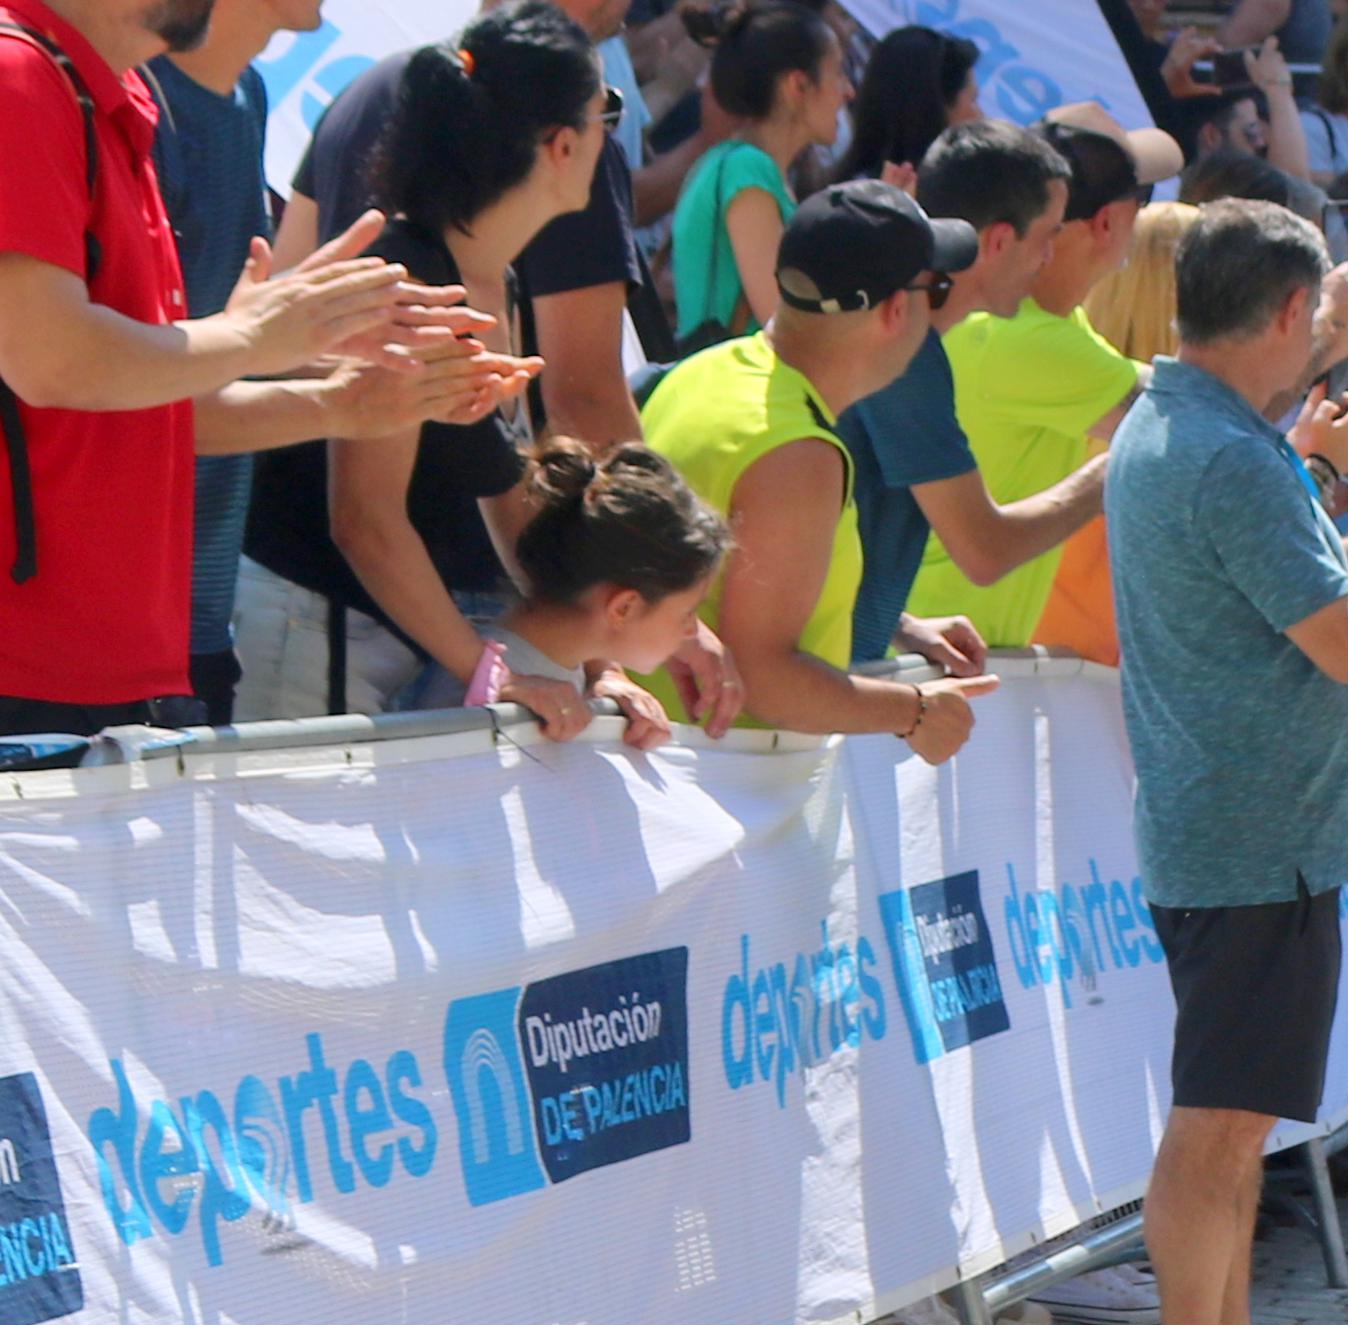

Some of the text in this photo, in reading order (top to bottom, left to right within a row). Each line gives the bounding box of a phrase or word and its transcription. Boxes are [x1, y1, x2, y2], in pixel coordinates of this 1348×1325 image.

[1005, 858, 1166, 1010] deportes
[525, 991, 662, 1074] Diputación
[87, 1031, 440, 1268] deportes
[541, 1060, 686, 1146] DE PALENCIA
